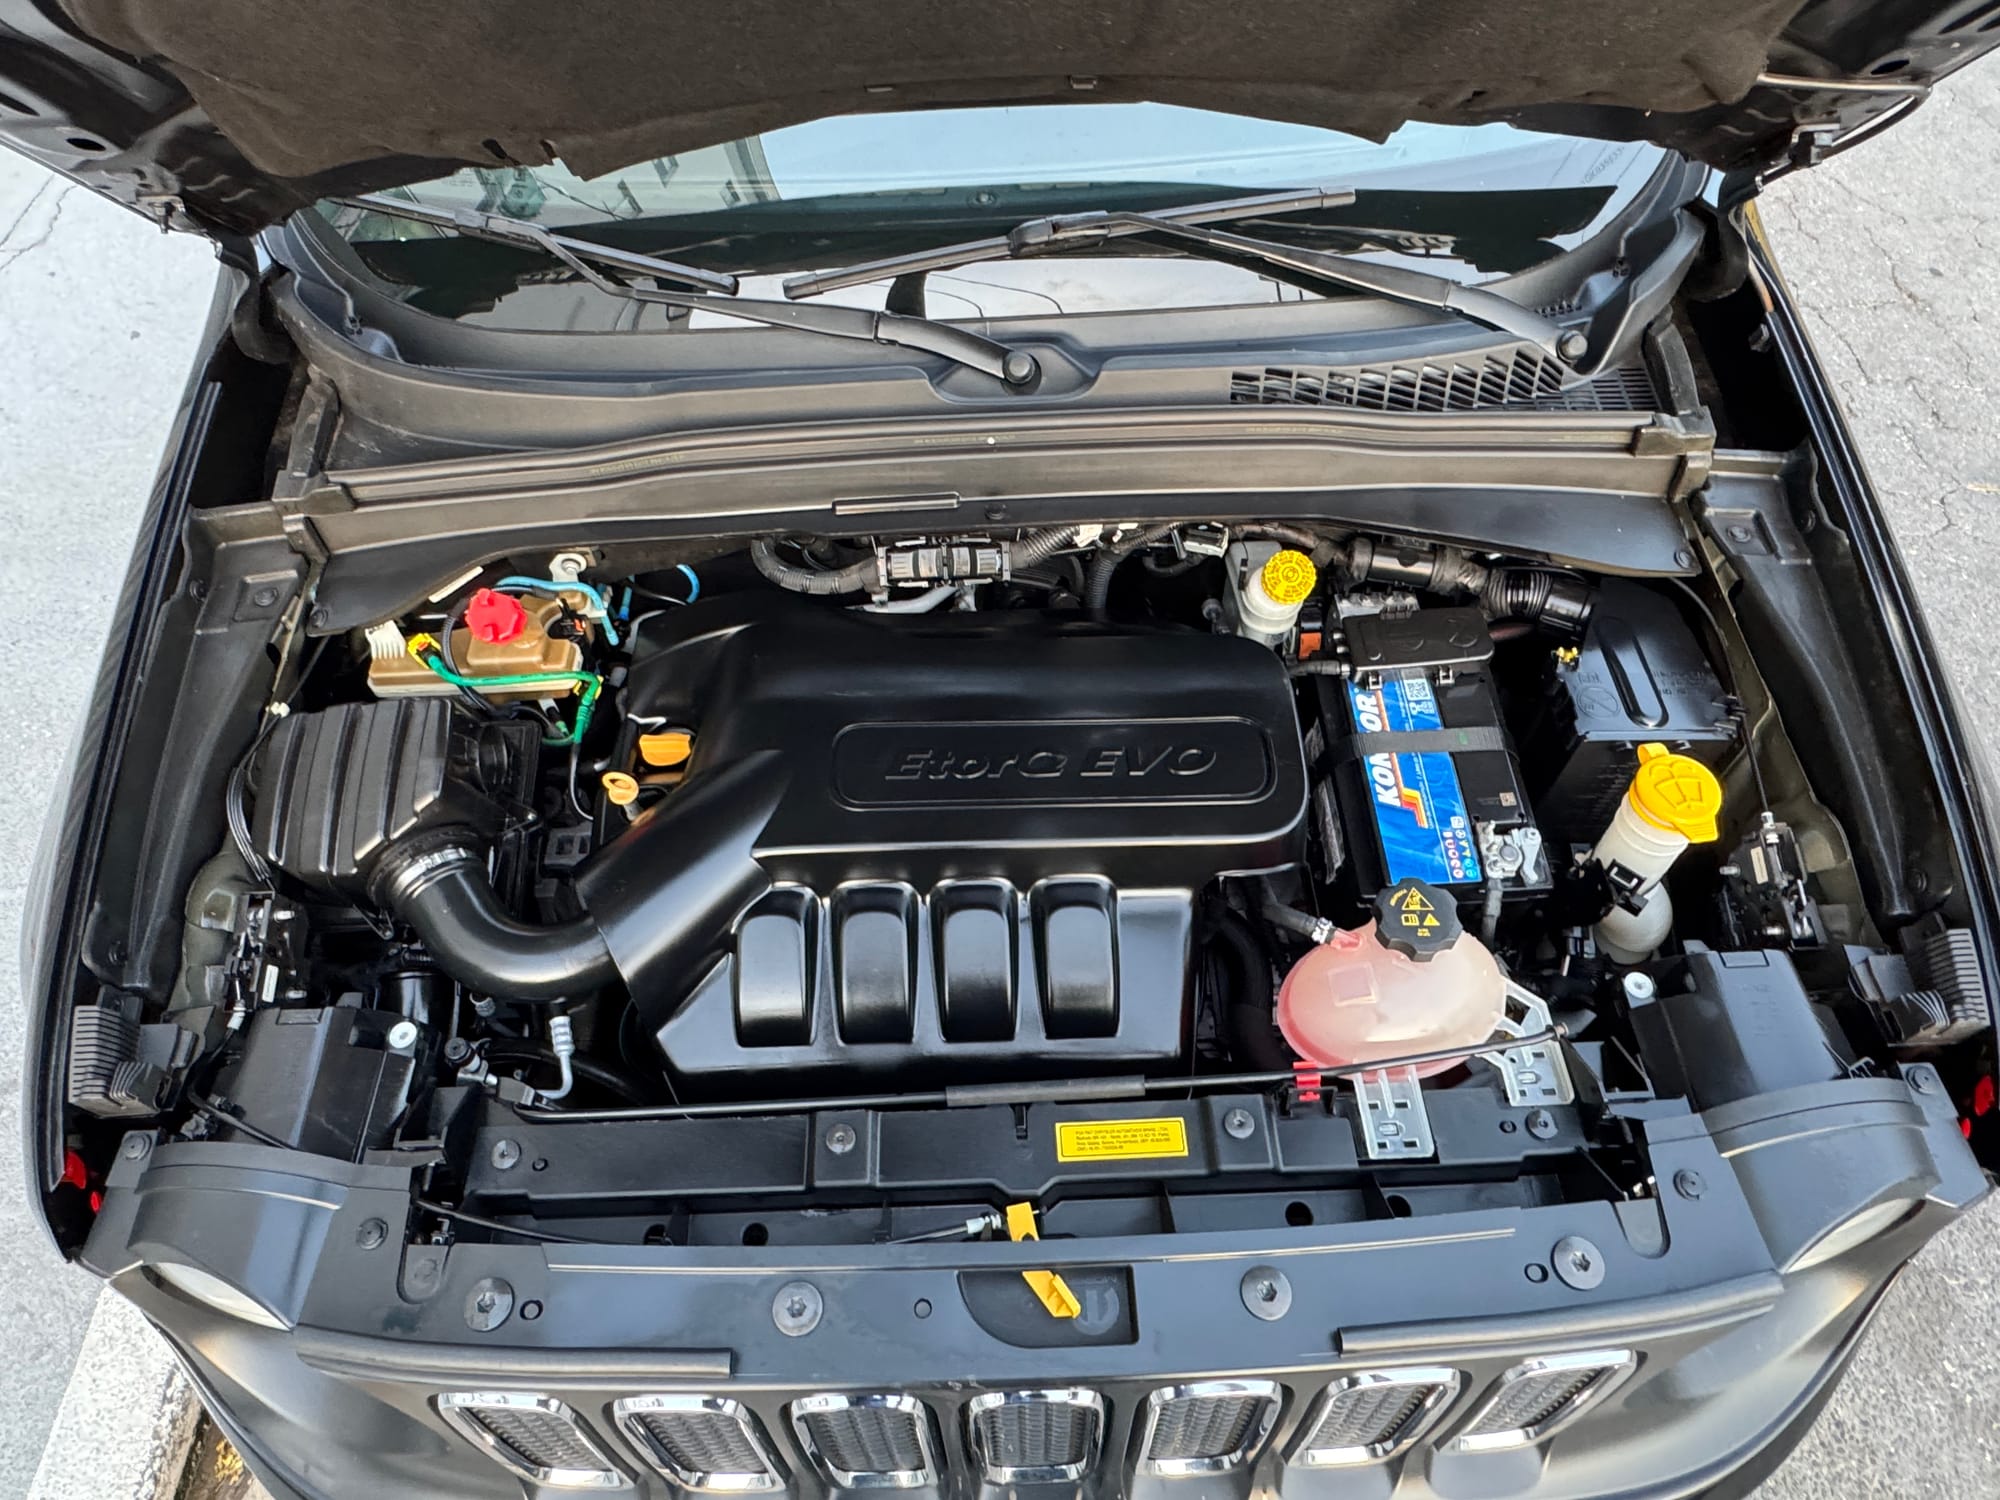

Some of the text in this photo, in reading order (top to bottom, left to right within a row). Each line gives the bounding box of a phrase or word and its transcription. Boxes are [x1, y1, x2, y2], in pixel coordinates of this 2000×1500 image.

[885, 745, 1217, 781] EtorQ EVO
[1355, 694, 1402, 807] KONOR
